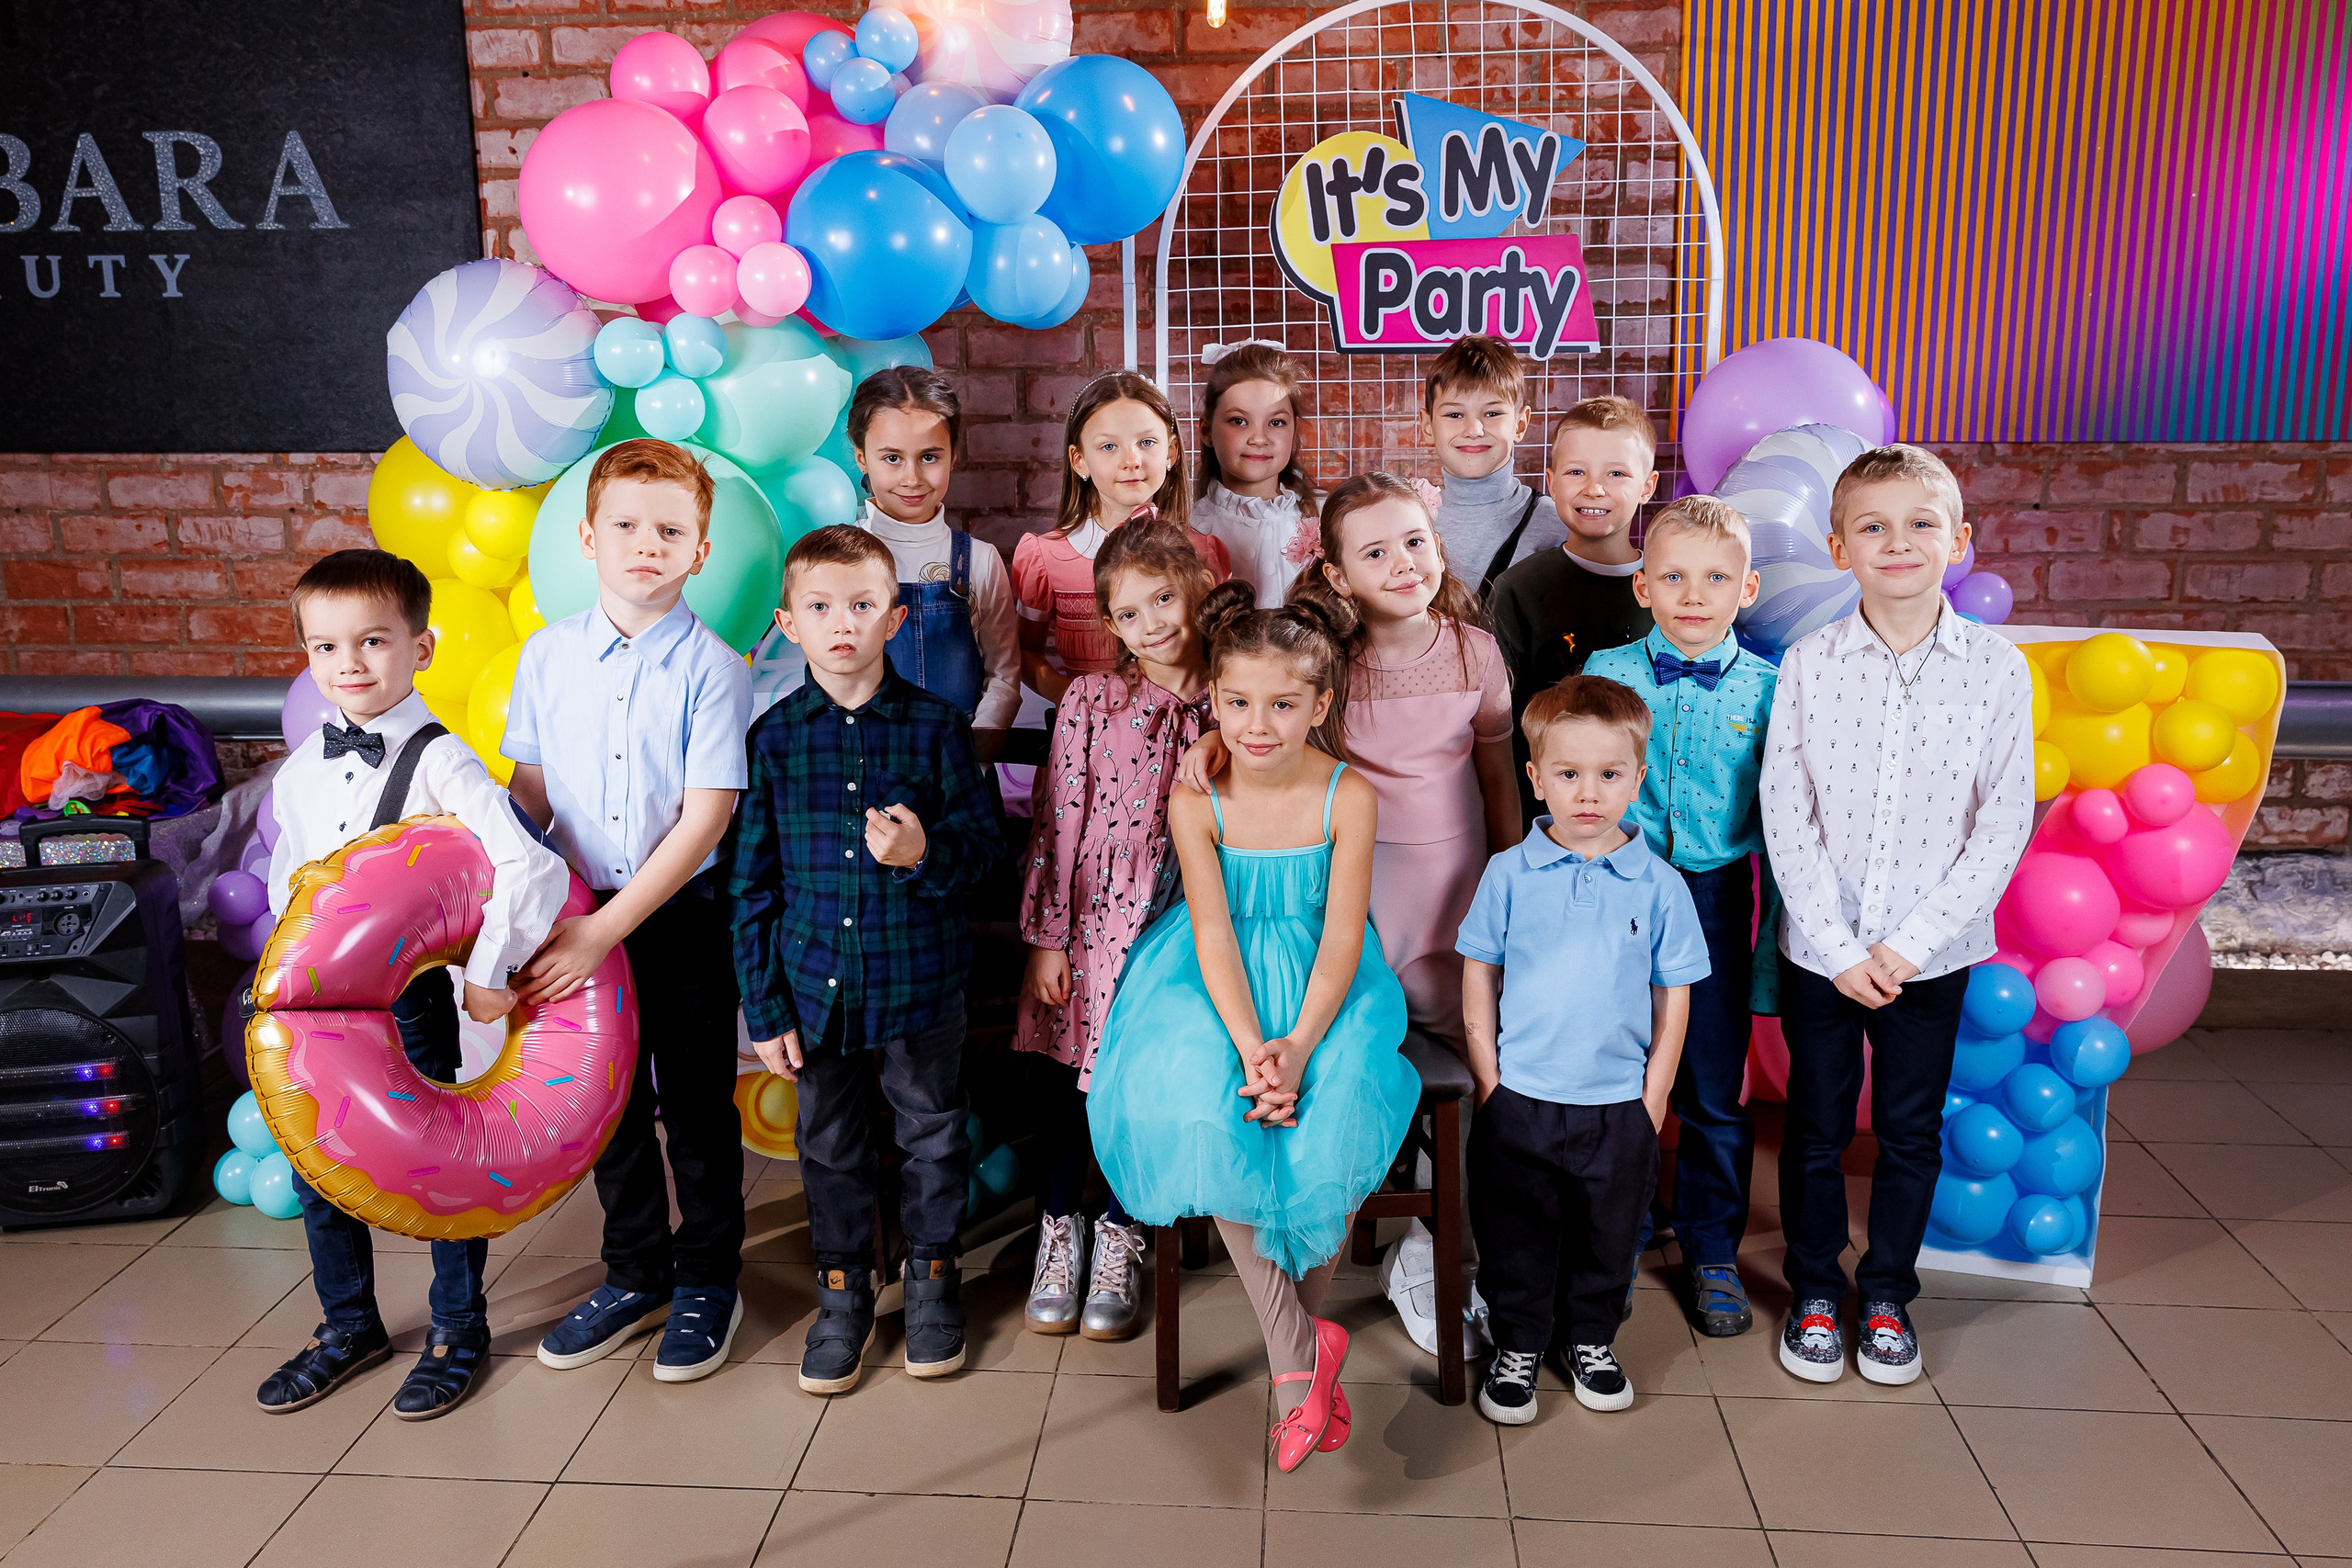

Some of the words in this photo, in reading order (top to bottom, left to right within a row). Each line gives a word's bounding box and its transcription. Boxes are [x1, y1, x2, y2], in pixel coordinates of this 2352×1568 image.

[1305, 145, 1426, 243] It's
[1442, 125, 1559, 226] My
[1362, 248, 1578, 359] Party
